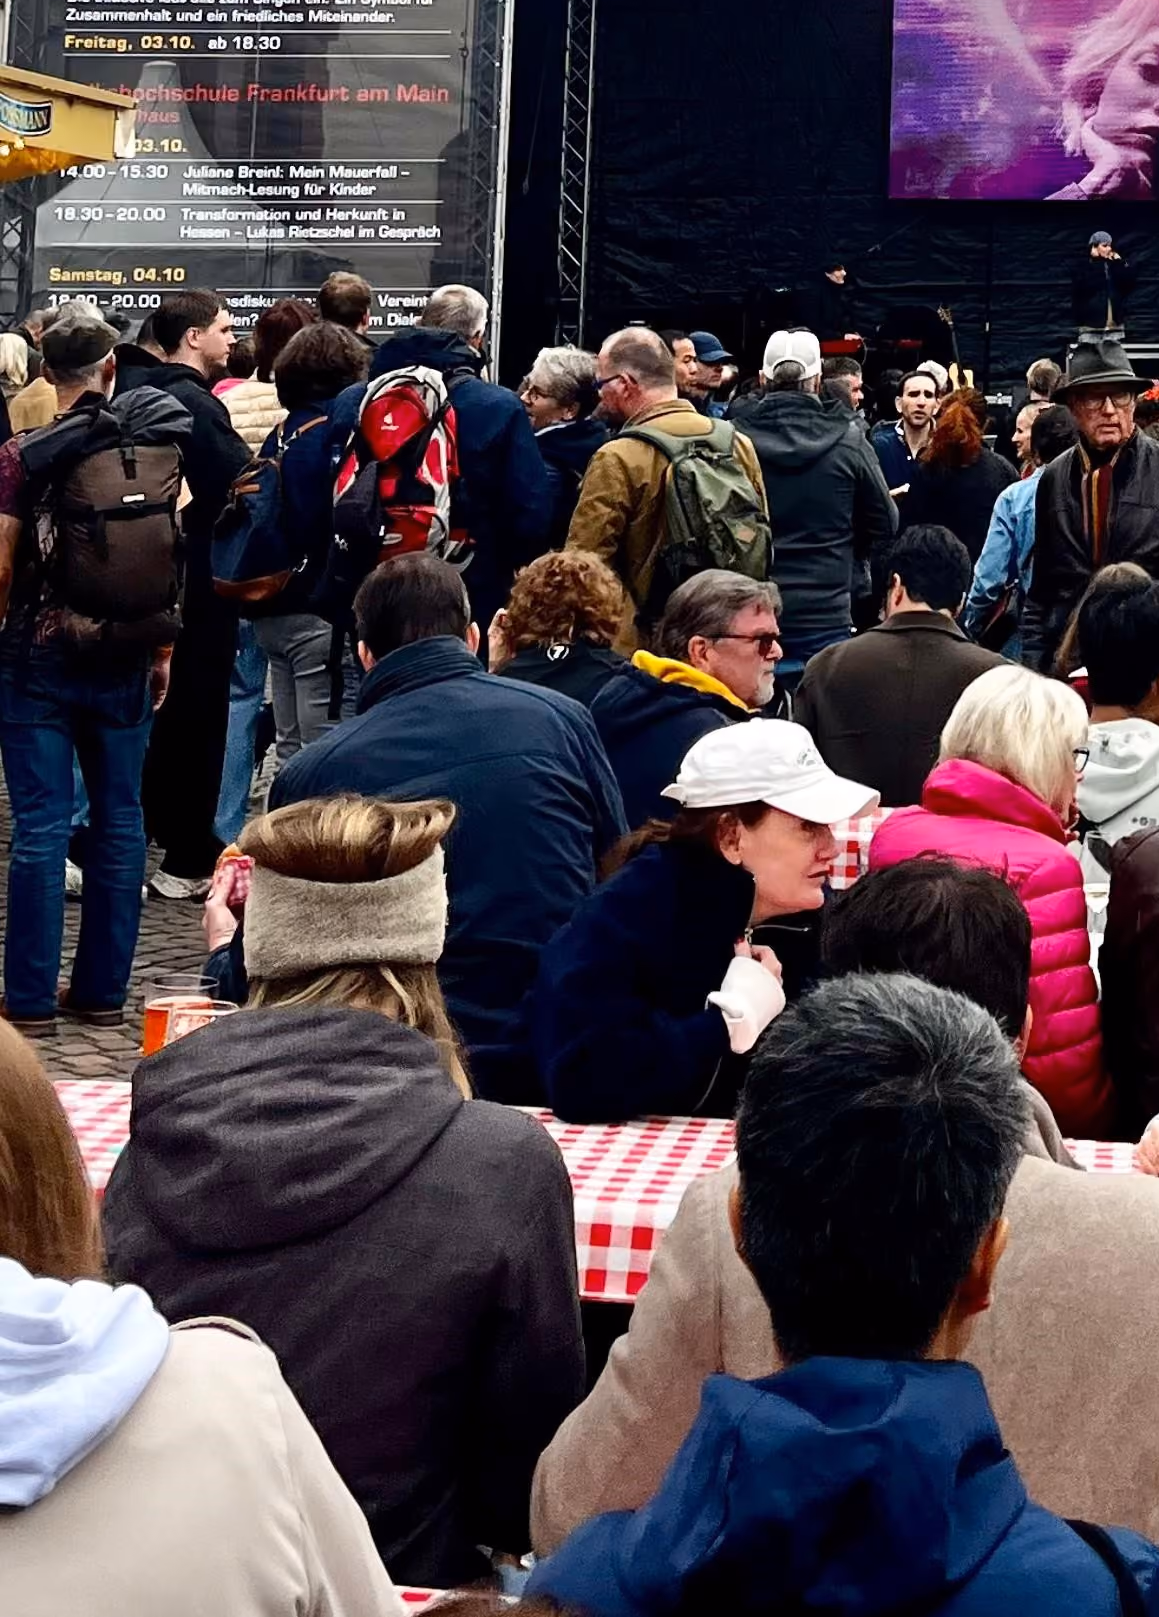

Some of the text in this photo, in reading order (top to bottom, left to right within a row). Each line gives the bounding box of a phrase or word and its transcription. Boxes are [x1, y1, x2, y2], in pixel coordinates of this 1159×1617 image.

[66, 8, 395, 23] Zusammenhalt und ein friedliches Miteinander.
[64, 35, 281, 52] Freitag, 03.10. ab 18.30
[247, 84, 349, 103] Frankfurt
[357, 87, 388, 102] am
[397, 85, 449, 102] Main
[183, 167, 234, 179] Juliane
[238, 166, 284, 179] Breinl:
[289, 167, 325, 179] Mein
[329, 165, 397, 179] Mauerfall
[182, 183, 377, 198] Mitmach-Lesung für Kinder
[180, 208, 291, 221] Transformation
[295, 208, 322, 221] und
[326, 208, 389, 221] Herkunft
[392, 208, 406, 221] in
[180, 225, 441, 241] Hessen Lukas Rietzschel im Gespräch
[49, 267, 186, 284] Samstag, 04.10
